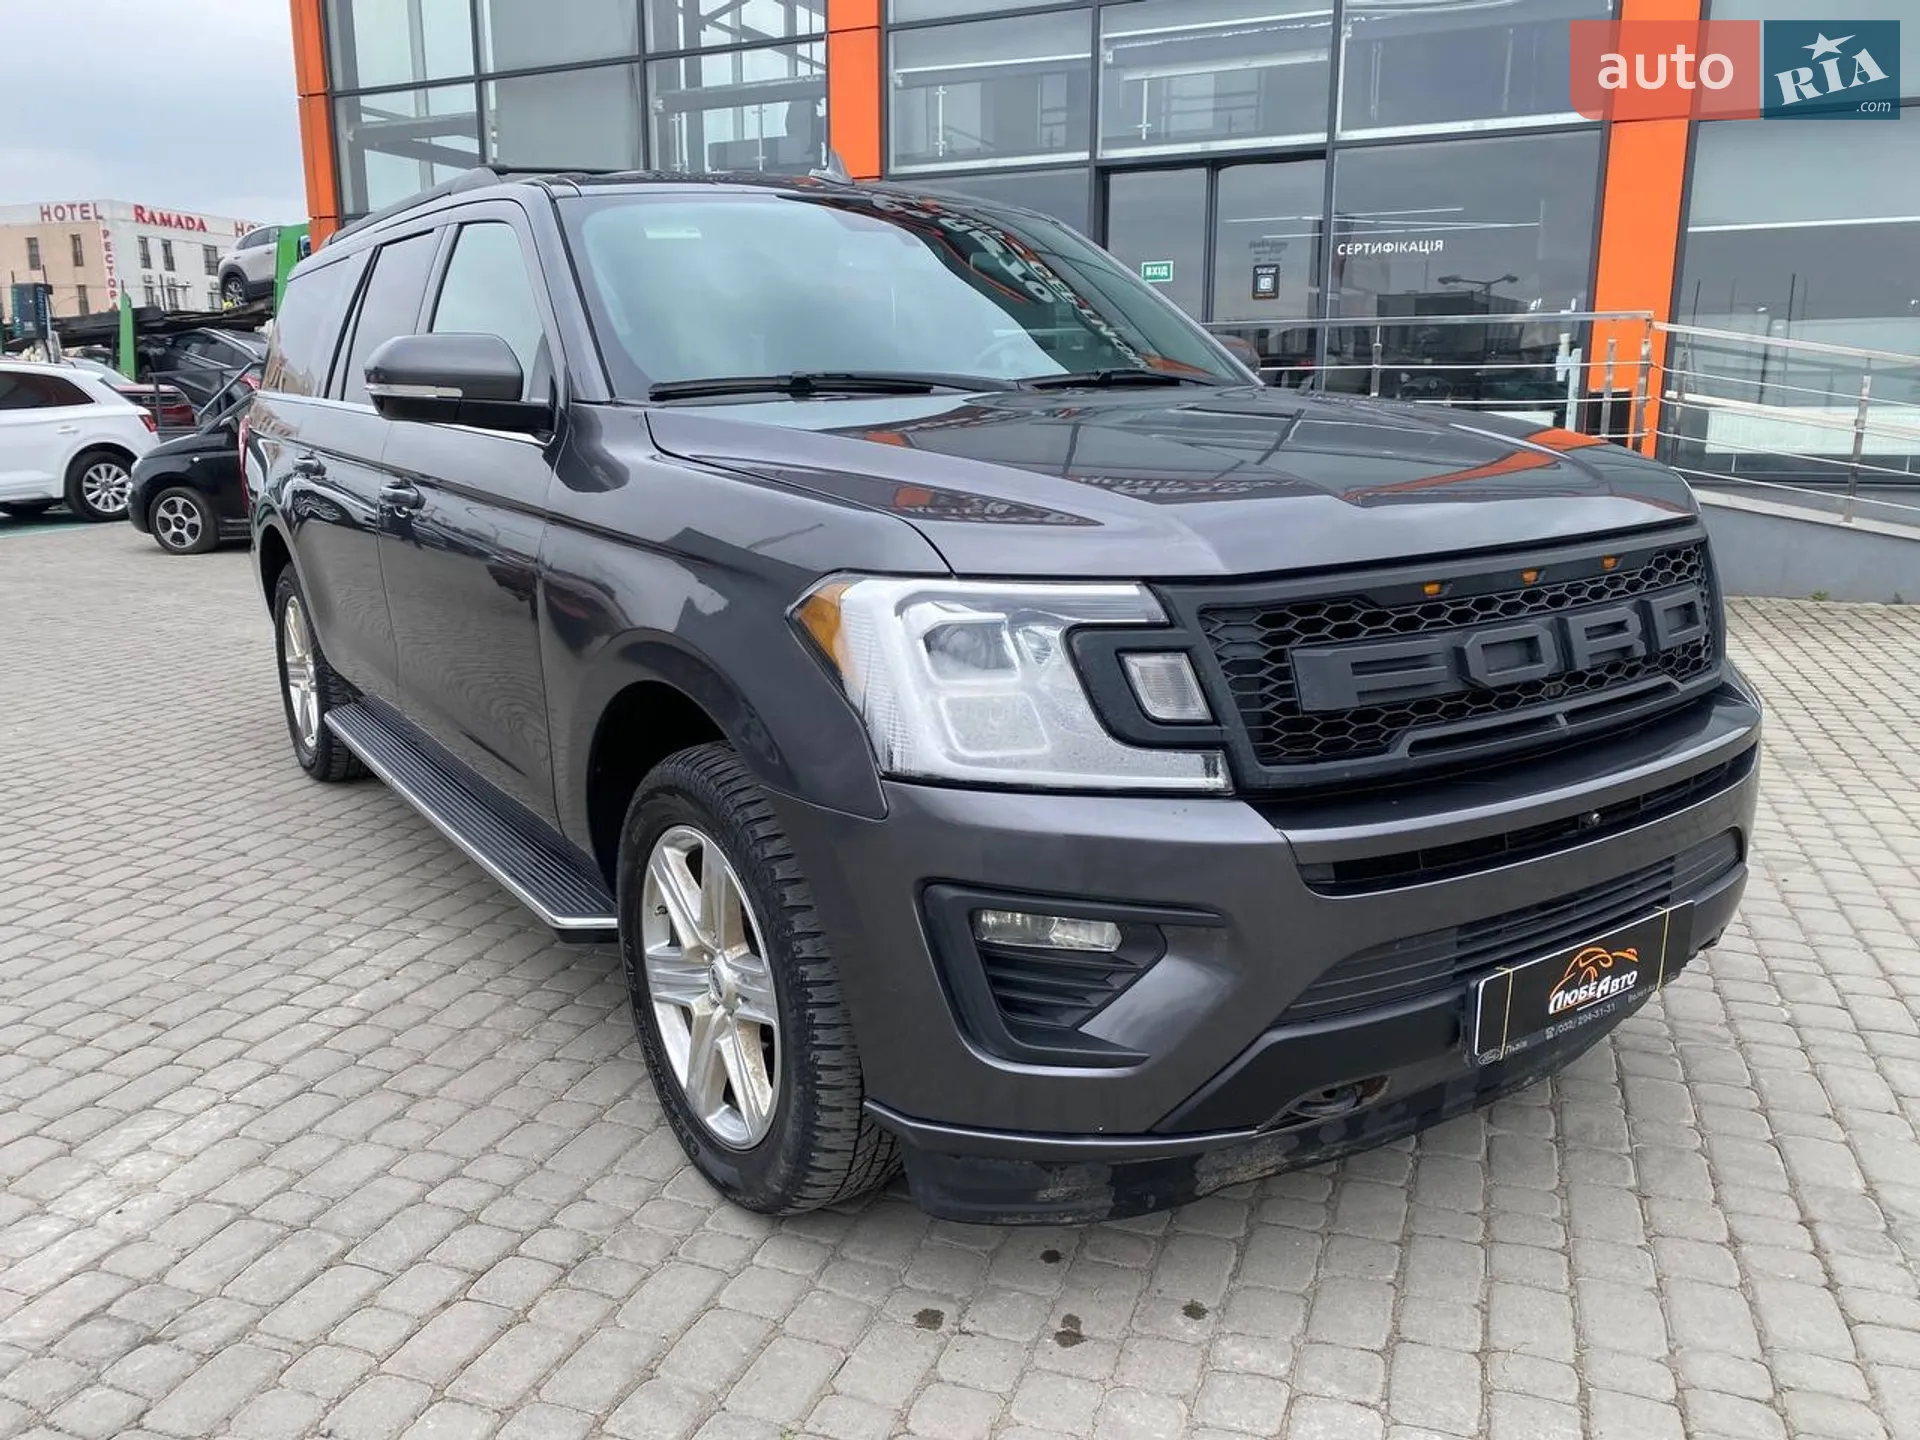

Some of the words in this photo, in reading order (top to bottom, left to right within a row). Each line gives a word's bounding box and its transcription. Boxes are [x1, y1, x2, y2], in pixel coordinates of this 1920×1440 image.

[40, 203, 103, 222] HOTEL
[134, 204, 207, 232] RAMADA
[1337, 239, 1444, 256] СЕРТИФІКАЦІЯ
[1145, 265, 1169, 278] ВХІД
[1291, 584, 1704, 712] FORD
